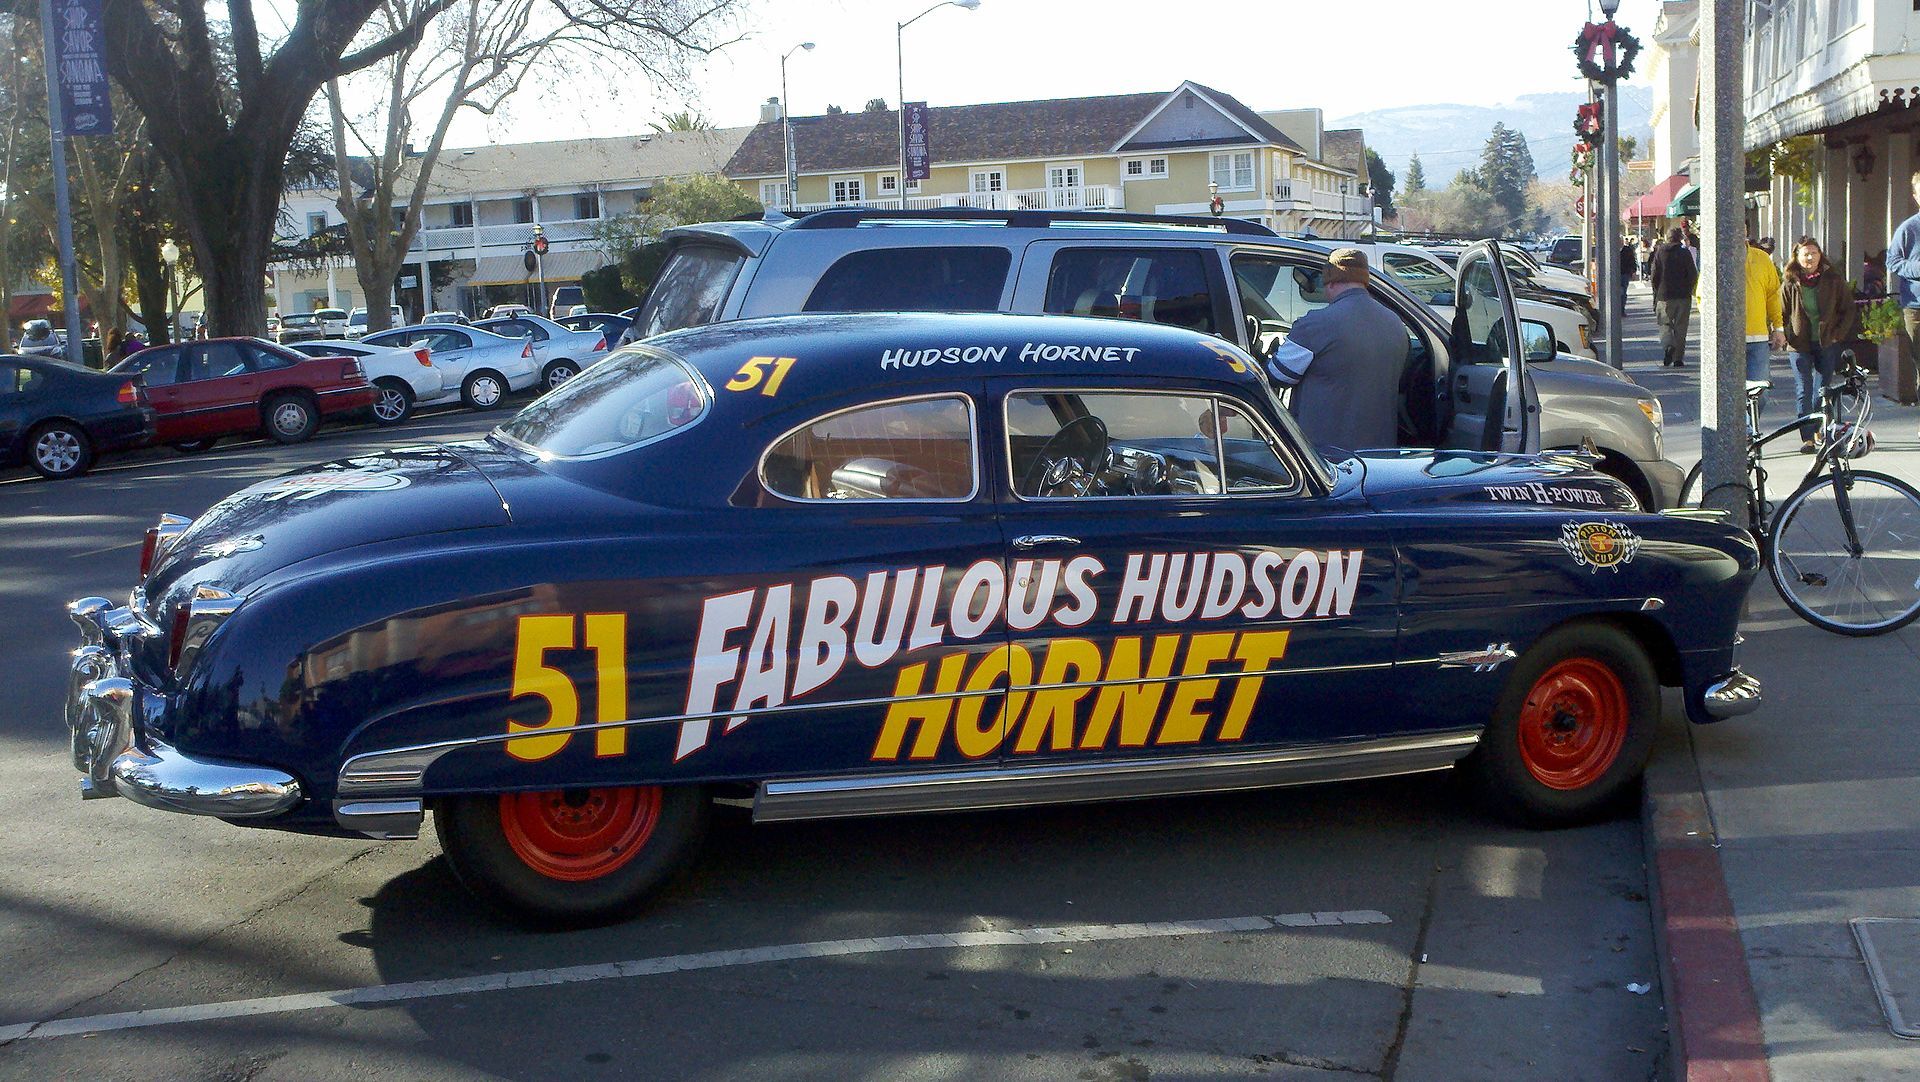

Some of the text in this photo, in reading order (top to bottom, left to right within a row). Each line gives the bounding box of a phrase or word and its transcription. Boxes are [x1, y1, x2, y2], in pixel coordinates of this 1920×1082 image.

[62, 30, 94, 52] SAVOR
[60, 59, 105, 83] SONOMA
[880, 343, 1141, 370] HUDSON HORNET
[725, 356, 796, 397] 51
[1483, 486, 1532, 501] TWIN
[1580, 525, 1617, 539] PISTON
[1594, 553, 1614, 563] CUP
[674, 549, 1364, 762] FABULOUS HUDSON
[505, 612, 628, 763] 51
[870, 630, 1292, 762] HORNET
